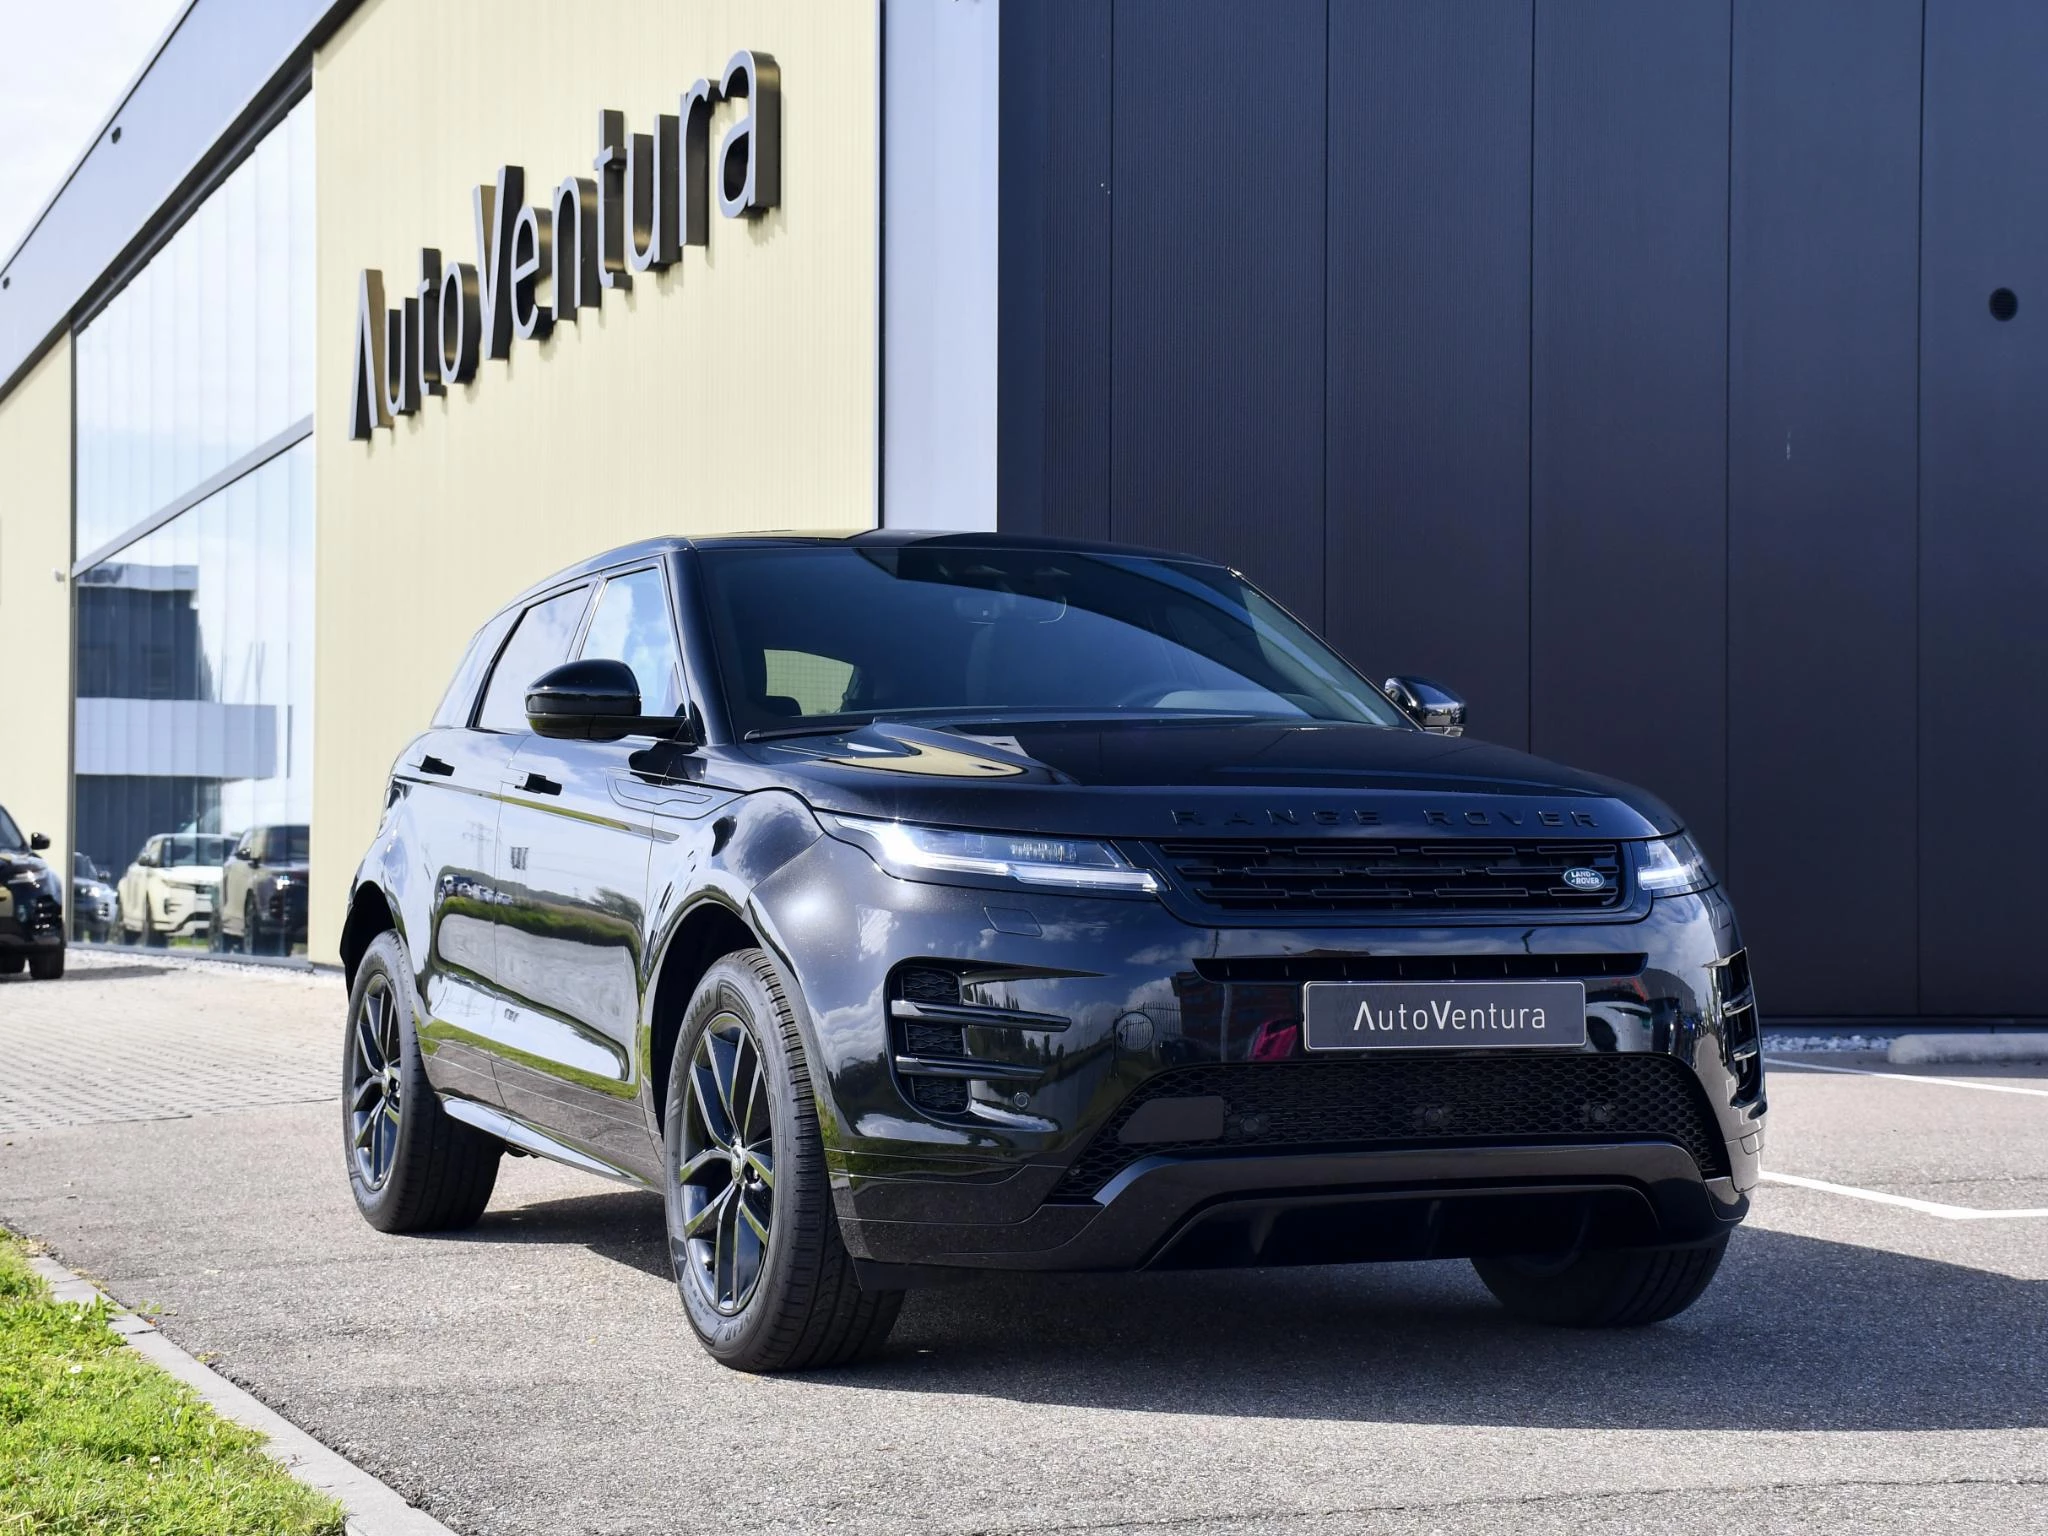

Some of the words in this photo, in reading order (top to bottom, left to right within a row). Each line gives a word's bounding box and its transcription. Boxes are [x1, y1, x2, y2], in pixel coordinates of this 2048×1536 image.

[349, 50, 781, 441] AutoVentura
[1170, 808, 1383, 826] RANGE
[1423, 809, 1598, 827] ROVER
[1575, 877, 1600, 885] ROVER
[1353, 1000, 1545, 1031] AutoVentura
